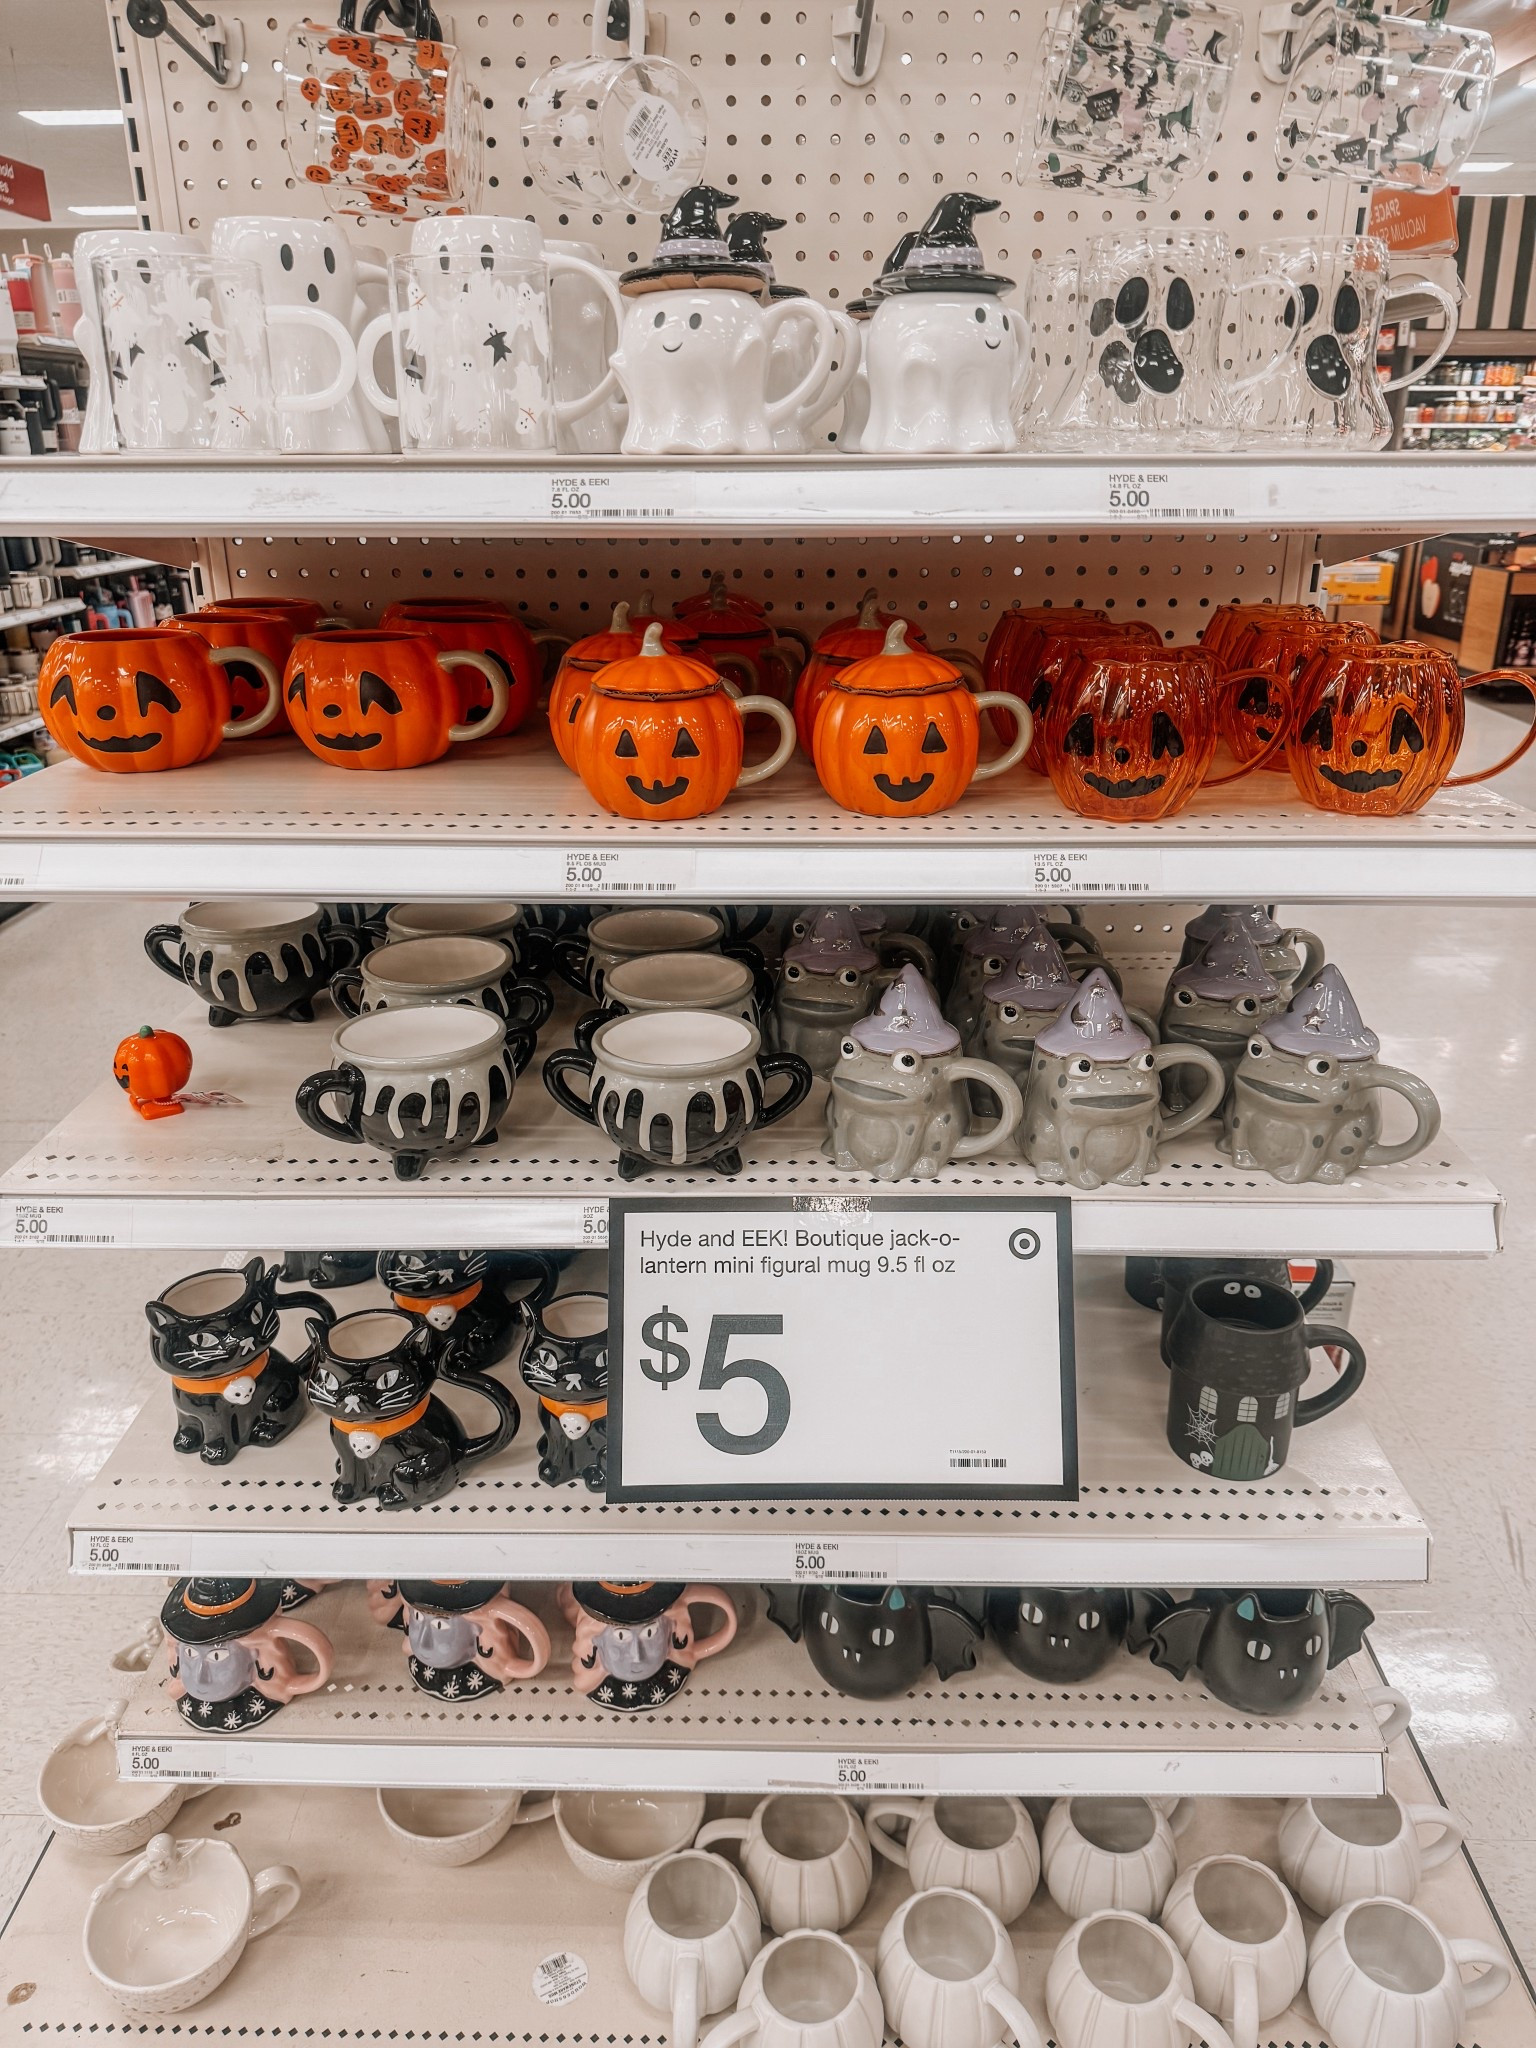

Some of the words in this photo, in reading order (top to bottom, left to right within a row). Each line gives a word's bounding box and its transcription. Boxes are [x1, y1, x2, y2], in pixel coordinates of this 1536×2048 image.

[662, 147, 673, 163] EEK!
[665, 149, 679, 171] HYDE
[551, 479, 578, 487] HYDE
[580, 479, 586, 487] &
[588, 478, 610, 486] EEK!
[1109, 474, 1136, 483] HYDE
[1137, 474, 1144, 483] &
[1147, 475, 1168, 483] EEK!
[551, 493, 591, 508] 5.00
[1109, 490, 1150, 507] 5.00
[566, 853, 591, 861] HYDE
[566, 867, 602, 881] 5.00
[1034, 867, 1071, 882] 5.00
[46, 1206, 64, 1214] EEK!
[15, 1219, 48, 1233] 5.00
[583, 1219, 609, 1234] 5.0
[641, 1230, 692, 1251] Hyde
[698, 1230, 734, 1247] and
[742, 1229, 788, 1247] EEK!
[795, 1229, 884, 1251] Boutique
[889, 1229, 960, 1251] jack-o-
[641, 1256, 707, 1274] lantern
[714, 1256, 754, 1273] mini
[761, 1256, 821, 1278] figural
[828, 1259, 871, 1277] mug
[877, 1256, 907, 1273] 9.5
[913, 1256, 925, 1273] fl
[932, 1260, 956, 1273] oz
[640, 1305, 791, 1455] $5
[90, 1548, 119, 1562] 5.00
[796, 1556, 825, 1569] 5.00
[132, 1757, 159, 1769] 5.00
[838, 1770, 866, 1782] 5.00
